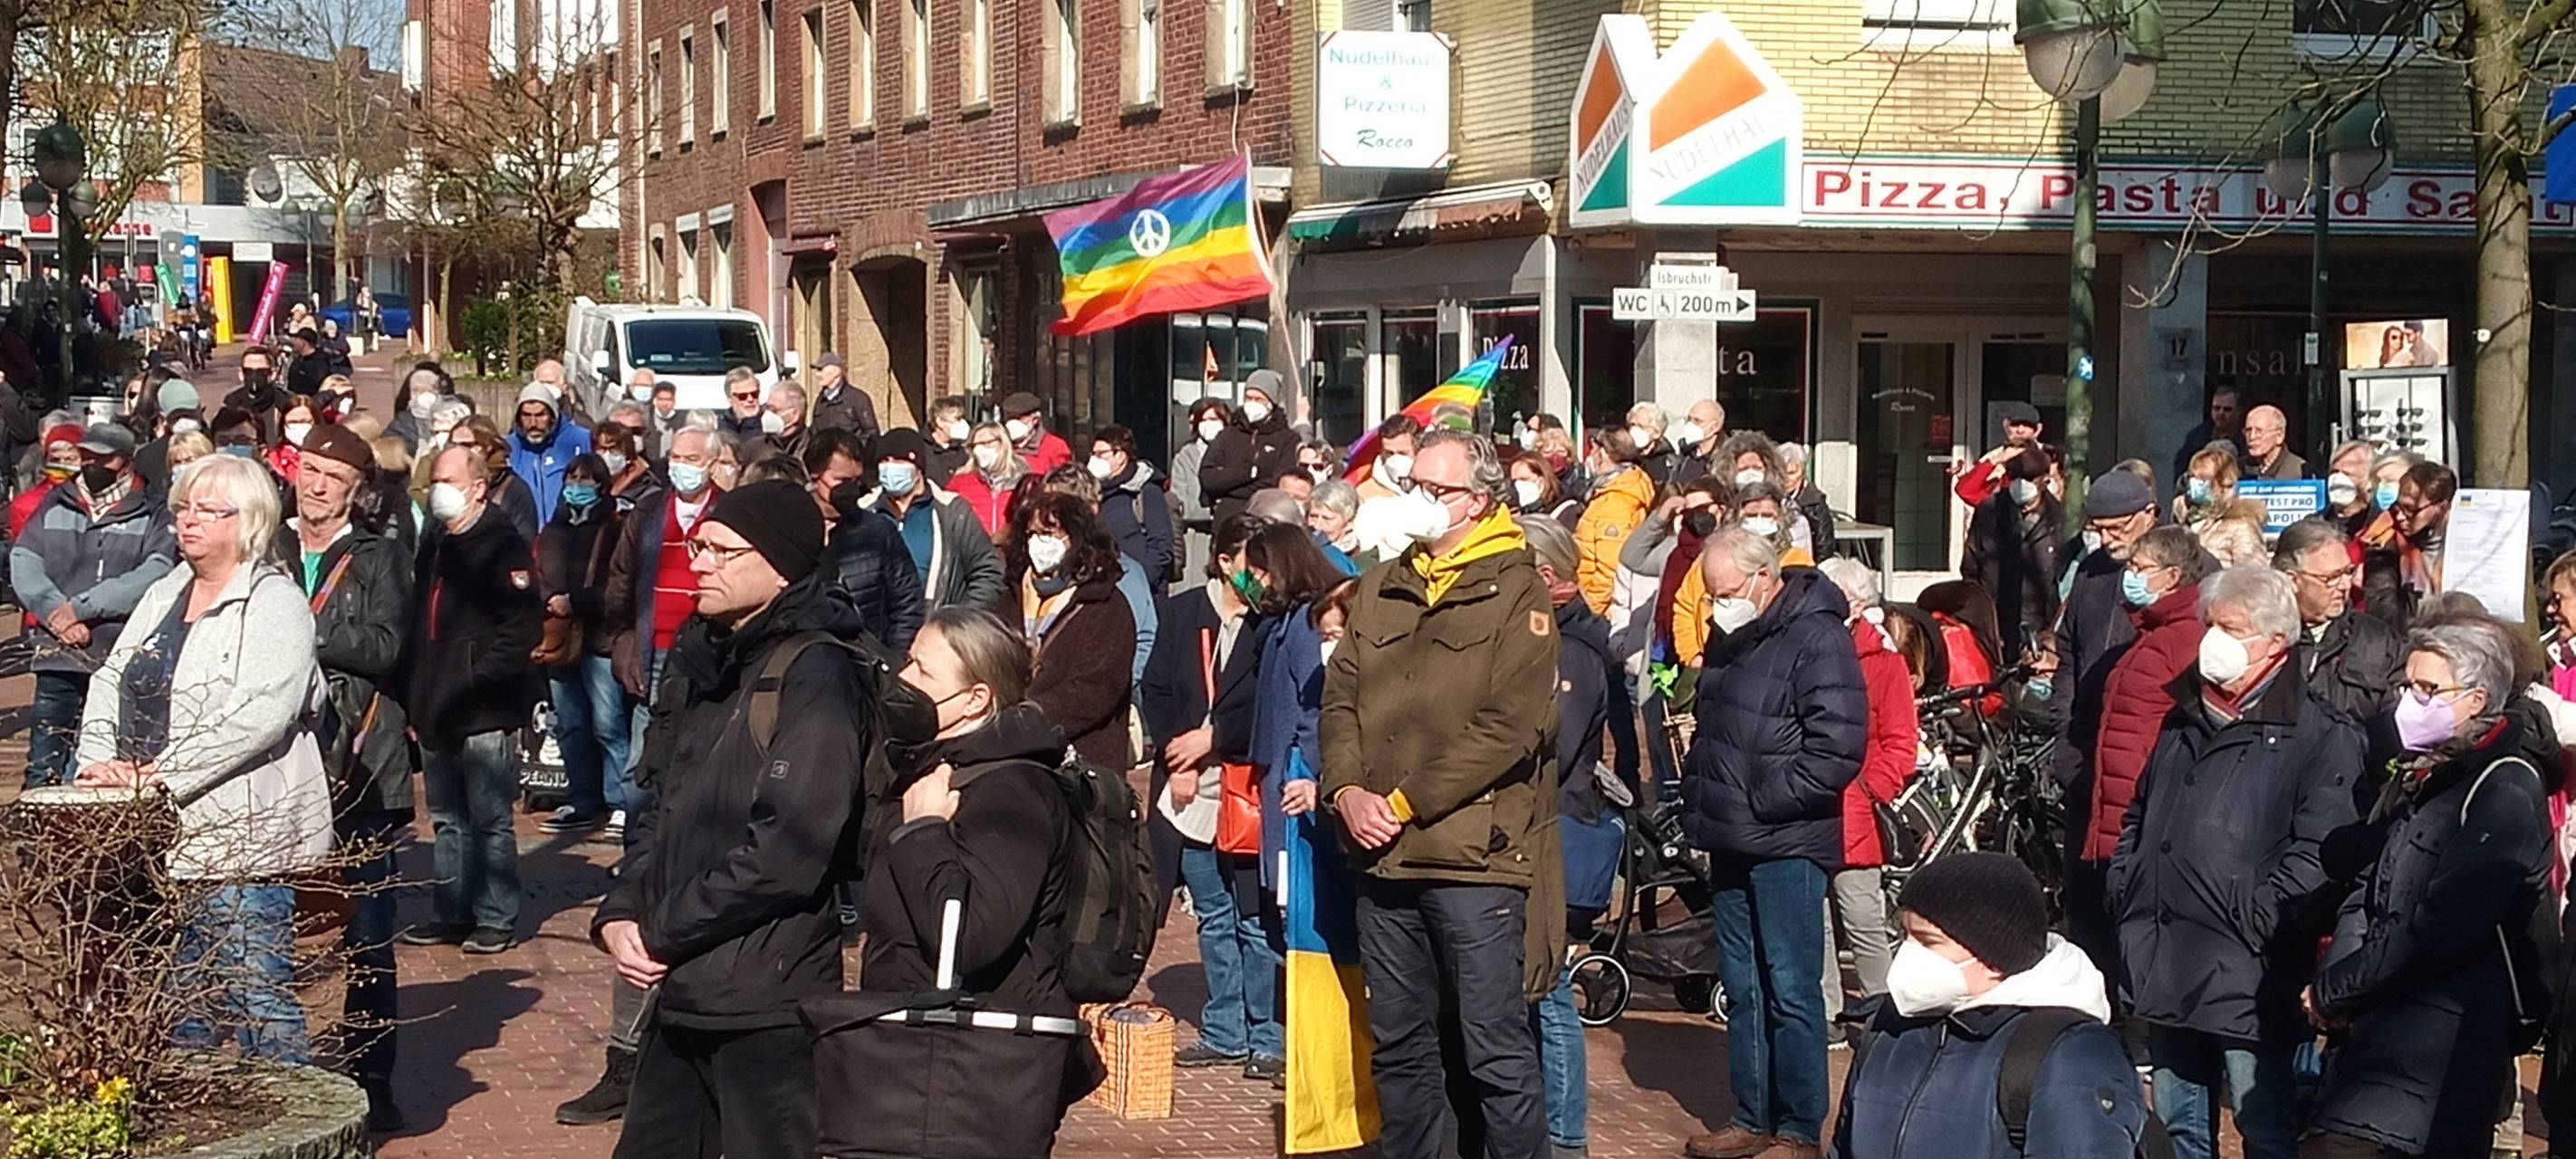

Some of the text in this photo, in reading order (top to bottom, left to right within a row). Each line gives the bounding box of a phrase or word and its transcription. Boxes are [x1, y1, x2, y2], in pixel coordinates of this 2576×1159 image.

[1329, 48, 1441, 66] Nudelhaus
[1379, 76, 1392, 90] &
[1344, 96, 1426, 113] Pizzeria
[1356, 129, 1414, 148] Rocco
[1576, 98, 1630, 198] NUDELHAUS
[1648, 108, 1783, 187] NUDELHAU
[1814, 170, 2009, 212] Pizza,
[1618, 295, 1648, 311] WC
[1483, 336, 1529, 370] Pzza
[2169, 337, 2187, 356] 17
